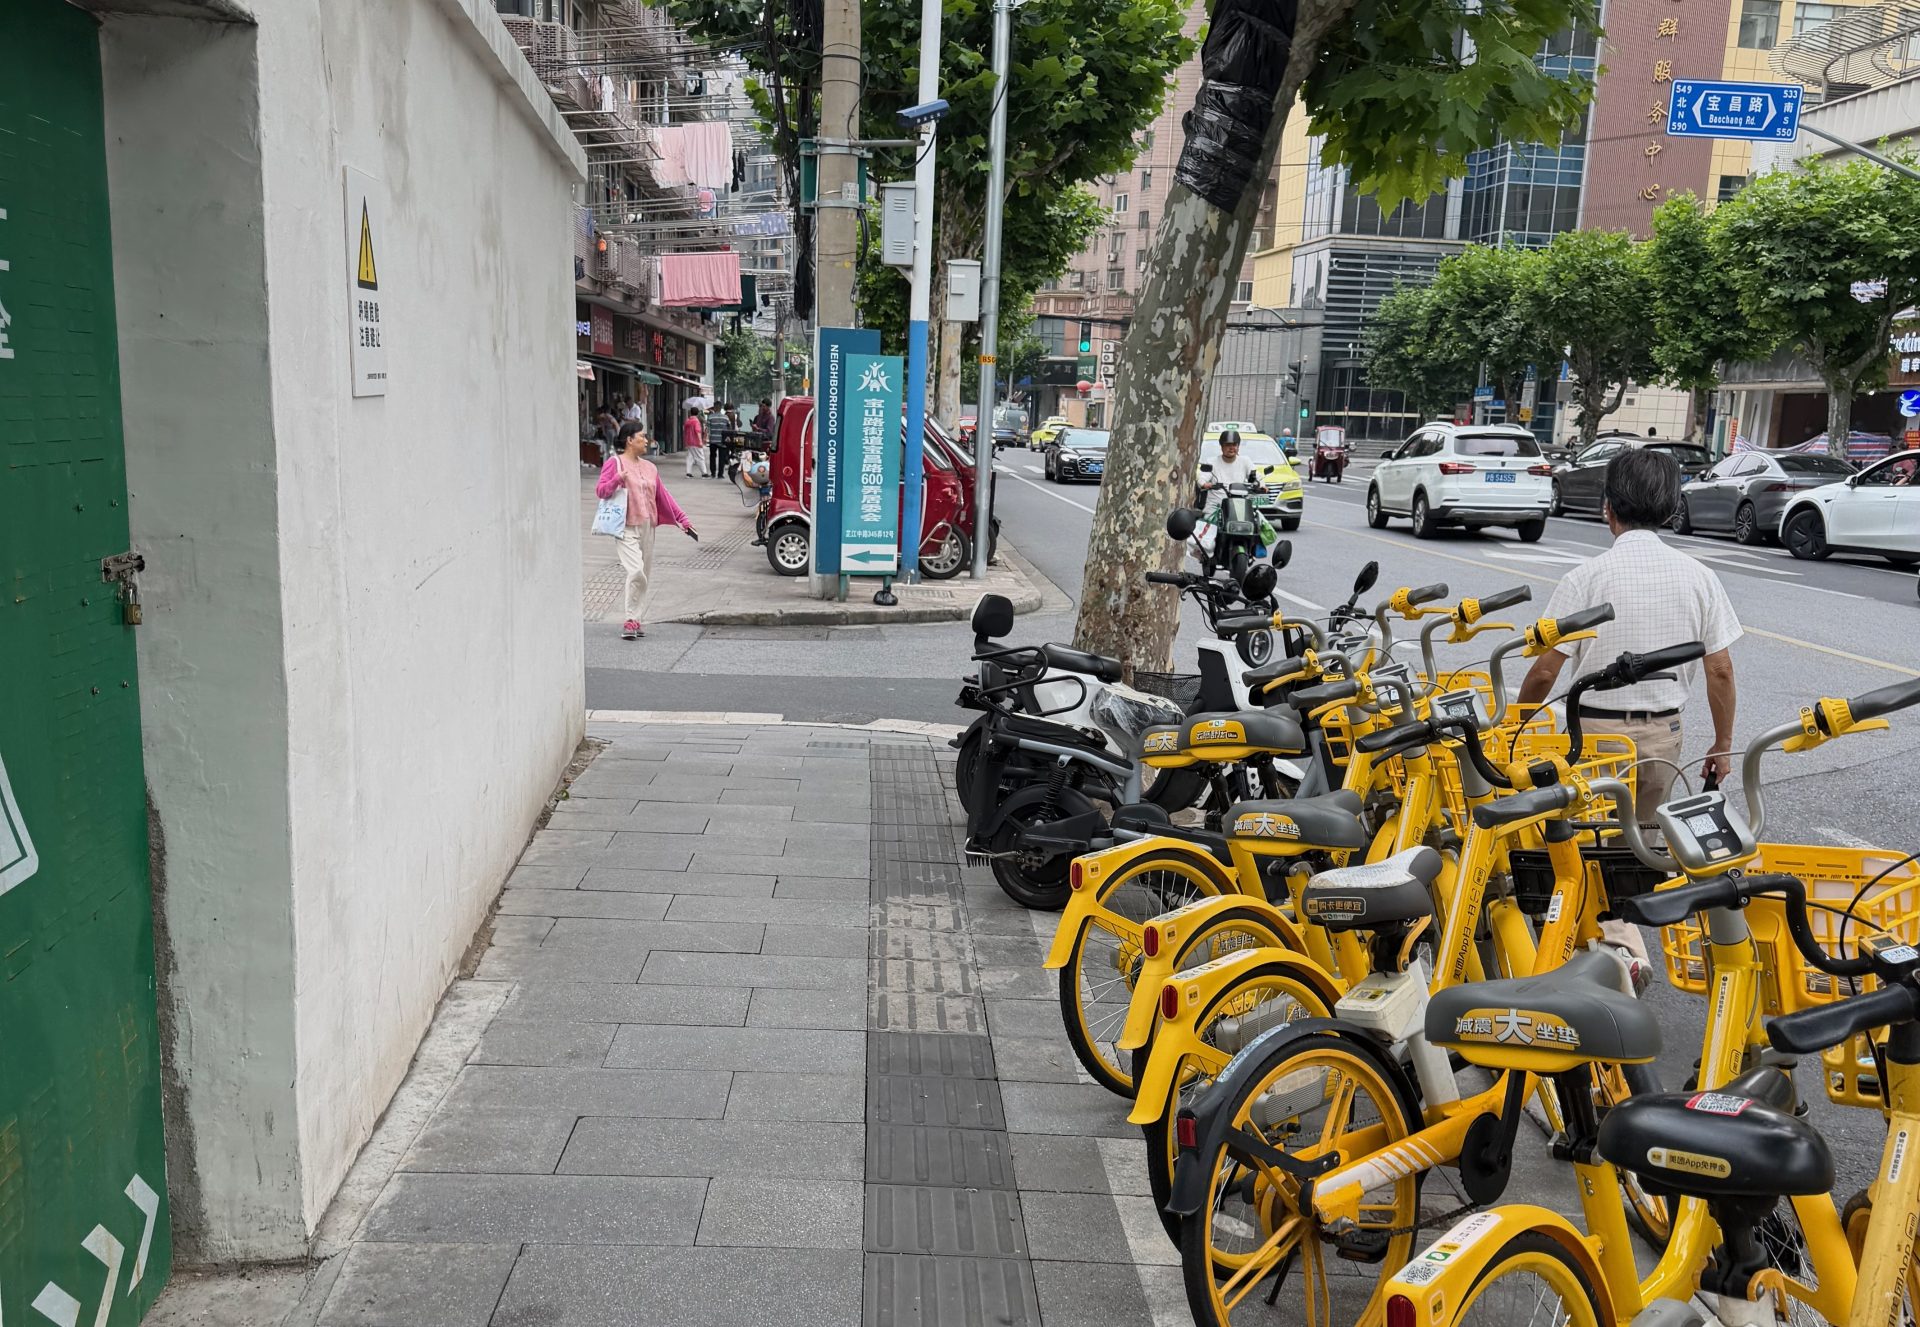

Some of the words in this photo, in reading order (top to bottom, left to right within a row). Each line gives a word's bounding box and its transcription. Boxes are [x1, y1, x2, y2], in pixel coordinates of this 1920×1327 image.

[1675, 84, 1693, 94] 549
[1783, 90, 1798, 99] 533
[1677, 97, 1687, 108] 北
[1706, 96, 1763, 113] 宝昌路
[1783, 102, 1794, 113] 南
[1677, 111, 1685, 119] N
[1708, 114, 1743, 127] Baochang
[1745, 115, 1756, 126] Rd.
[1782, 116, 1790, 125] S
[1671, 122, 1687, 131] 590
[1775, 128, 1792, 137] 550
[828, 344, 839, 435] NEIGHBORHOOD
[826, 439, 837, 503] COMMITTEE
